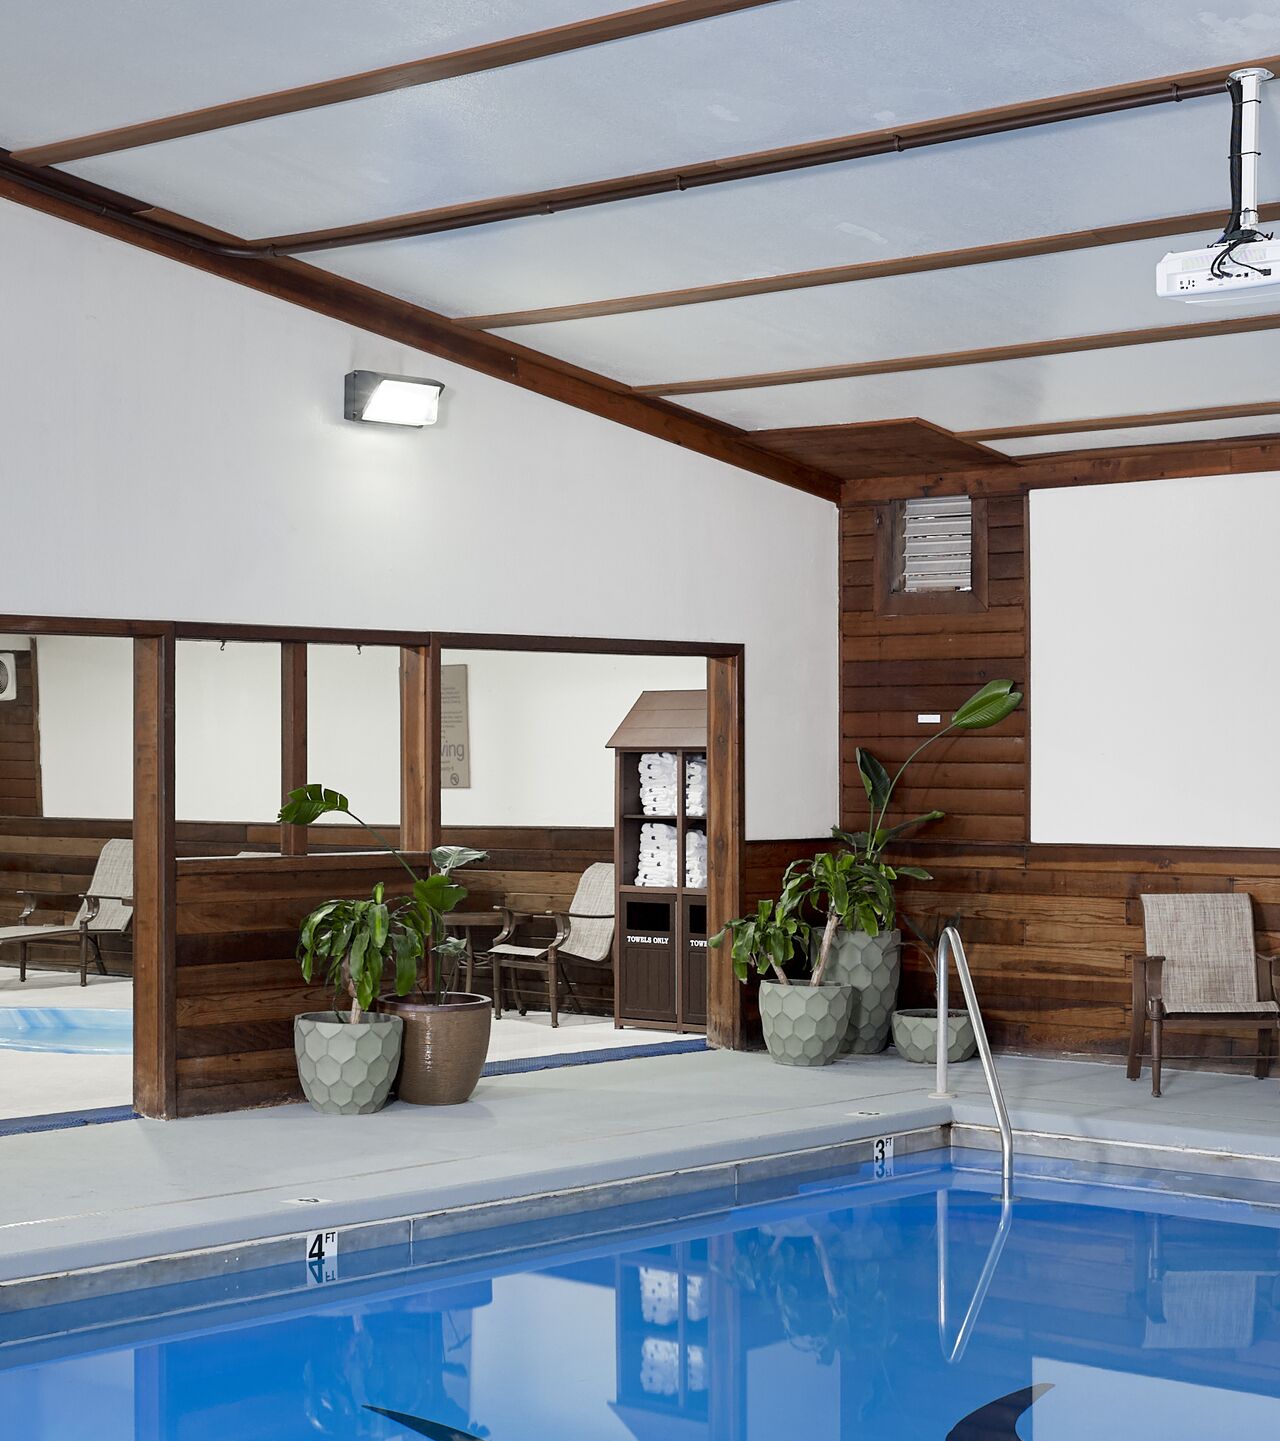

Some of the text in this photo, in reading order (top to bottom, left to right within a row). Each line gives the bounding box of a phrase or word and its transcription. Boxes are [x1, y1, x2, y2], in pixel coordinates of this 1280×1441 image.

[441, 739, 464, 761] ving
[875, 1137, 892, 1163] 3 FT
[308, 1232, 336, 1260] 4 FT
